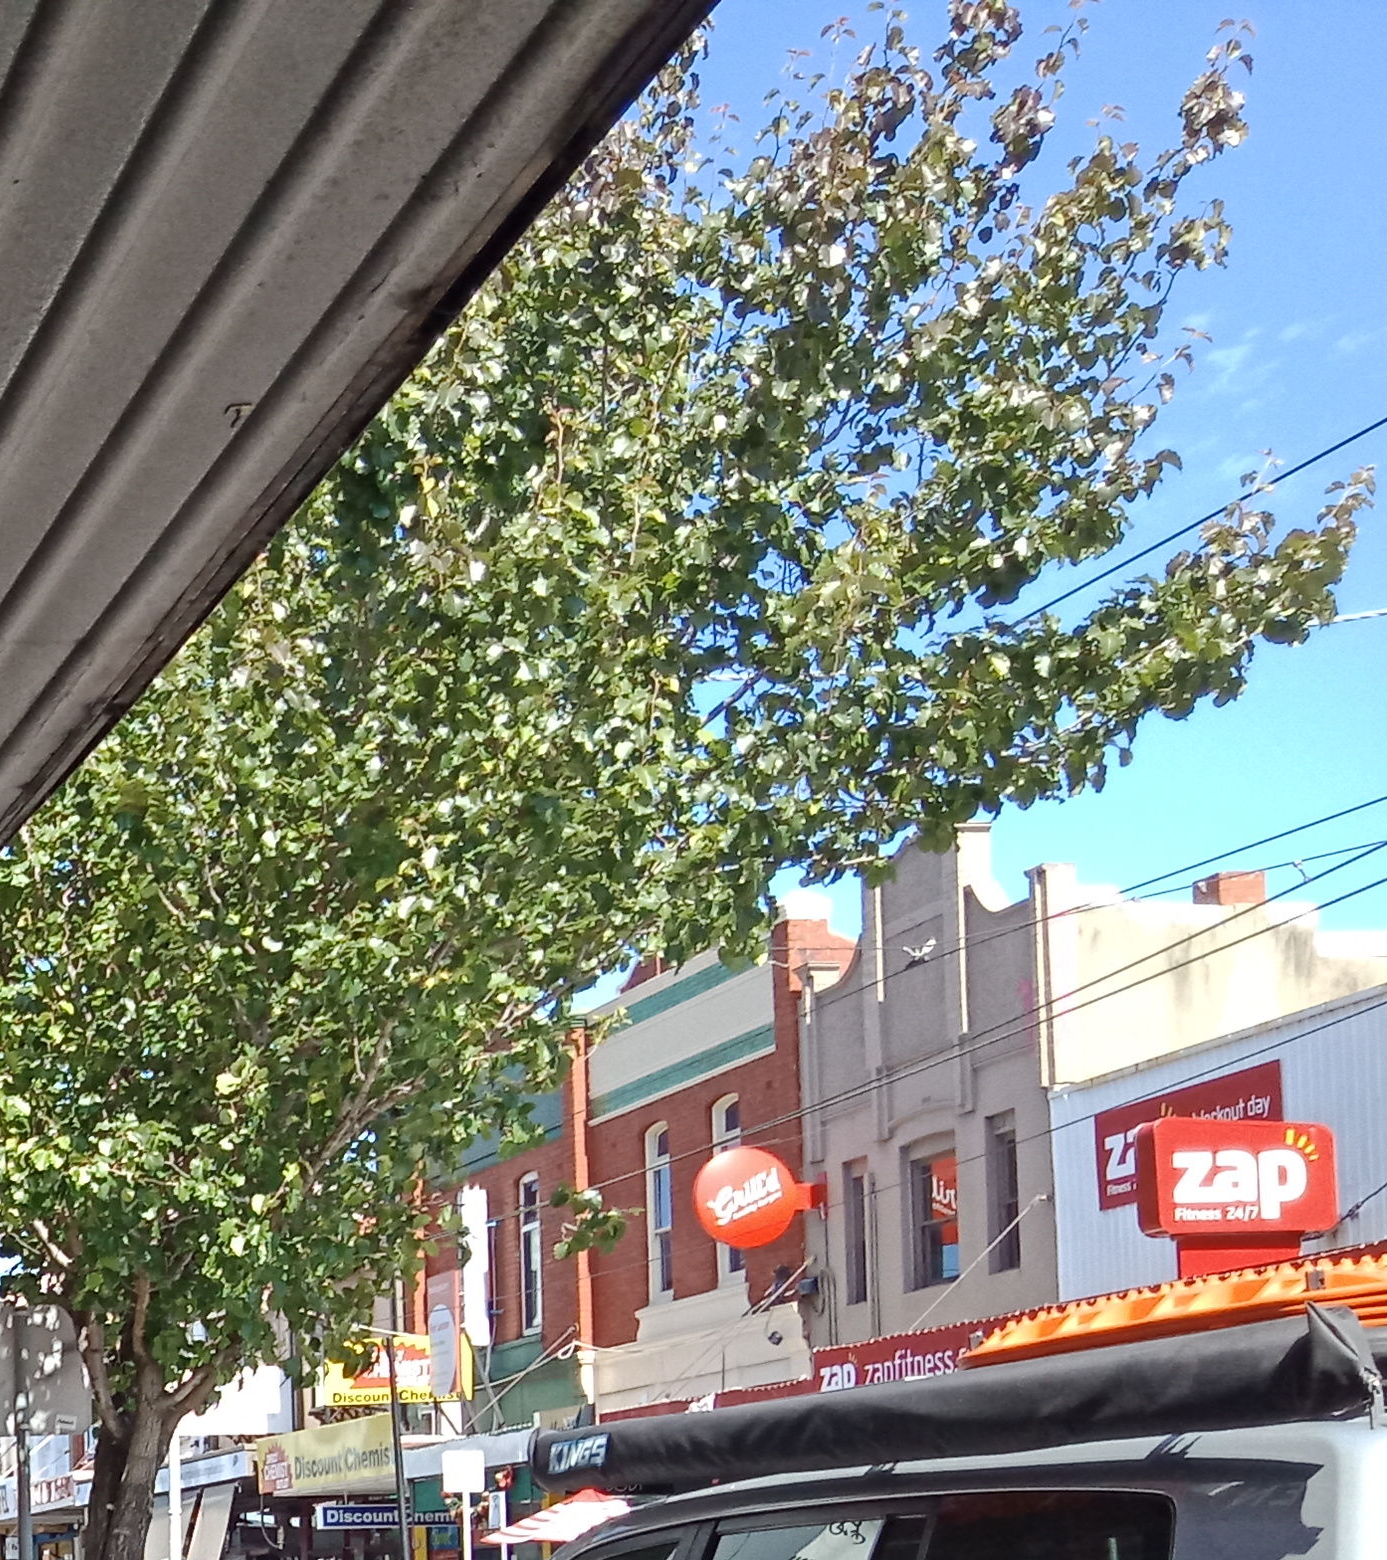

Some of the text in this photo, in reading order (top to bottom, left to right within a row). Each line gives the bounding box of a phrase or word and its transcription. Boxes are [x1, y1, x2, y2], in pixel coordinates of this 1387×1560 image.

[1247, 1094, 1272, 1118] day
[1171, 1148, 1308, 1220] zap
[1173, 1206, 1259, 1222] Fitness 24/7
[332, 1391, 392, 1404] Discoun
[294, 1452, 343, 1480] Discount
[548, 1434, 610, 1474] KINGS
[326, 1508, 399, 1524] Discount
